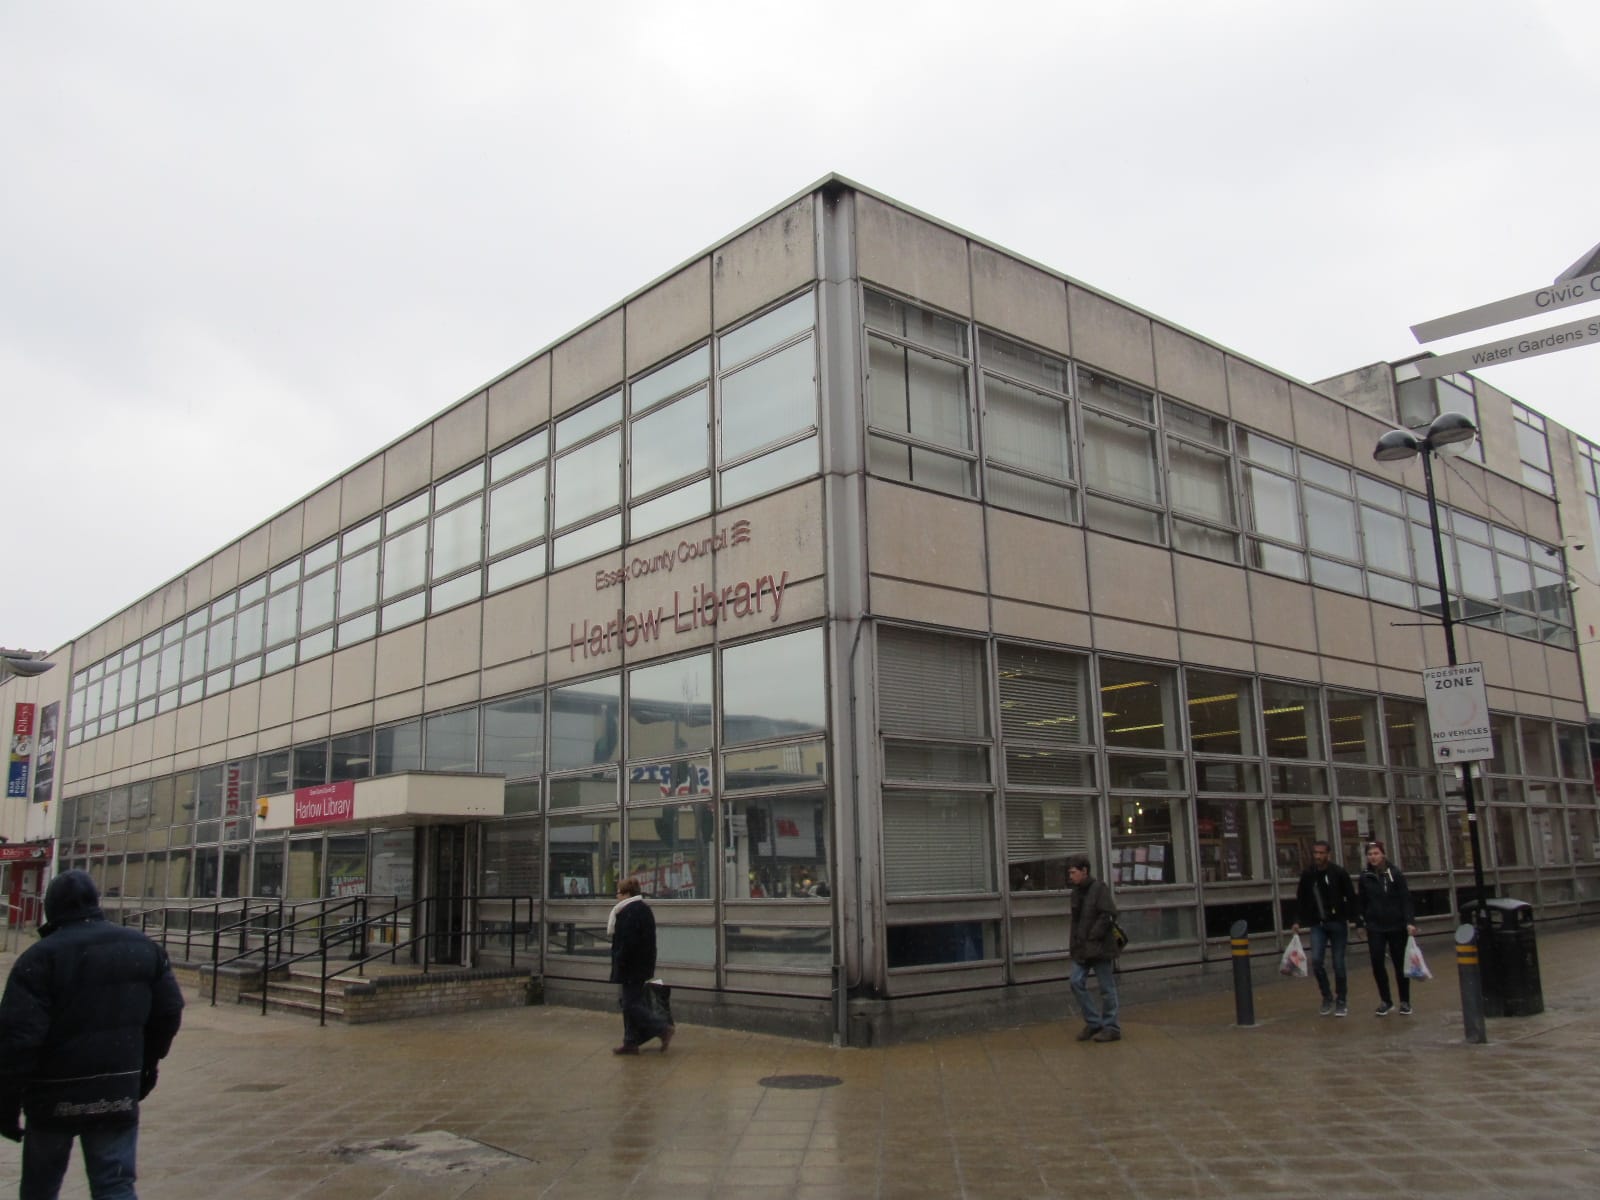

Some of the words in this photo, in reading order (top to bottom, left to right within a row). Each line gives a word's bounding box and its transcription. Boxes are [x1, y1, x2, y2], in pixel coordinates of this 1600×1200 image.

[1535, 284, 1584, 307] Civic
[1472, 347, 1514, 364] Water
[1518, 330, 1583, 353] Gardens
[595, 564, 631, 591] Essex
[631, 550, 677, 578] County
[678, 528, 728, 563] Council
[570, 607, 663, 662] Harlow
[674, 571, 789, 634] Library
[1425, 666, 1480, 679] PEDESTRIAN
[1435, 677, 1473, 690] ZONE
[1448, 727, 1488, 737] VEHICLES
[296, 800, 322, 819] Harlow
[323, 798, 350, 818] Library
